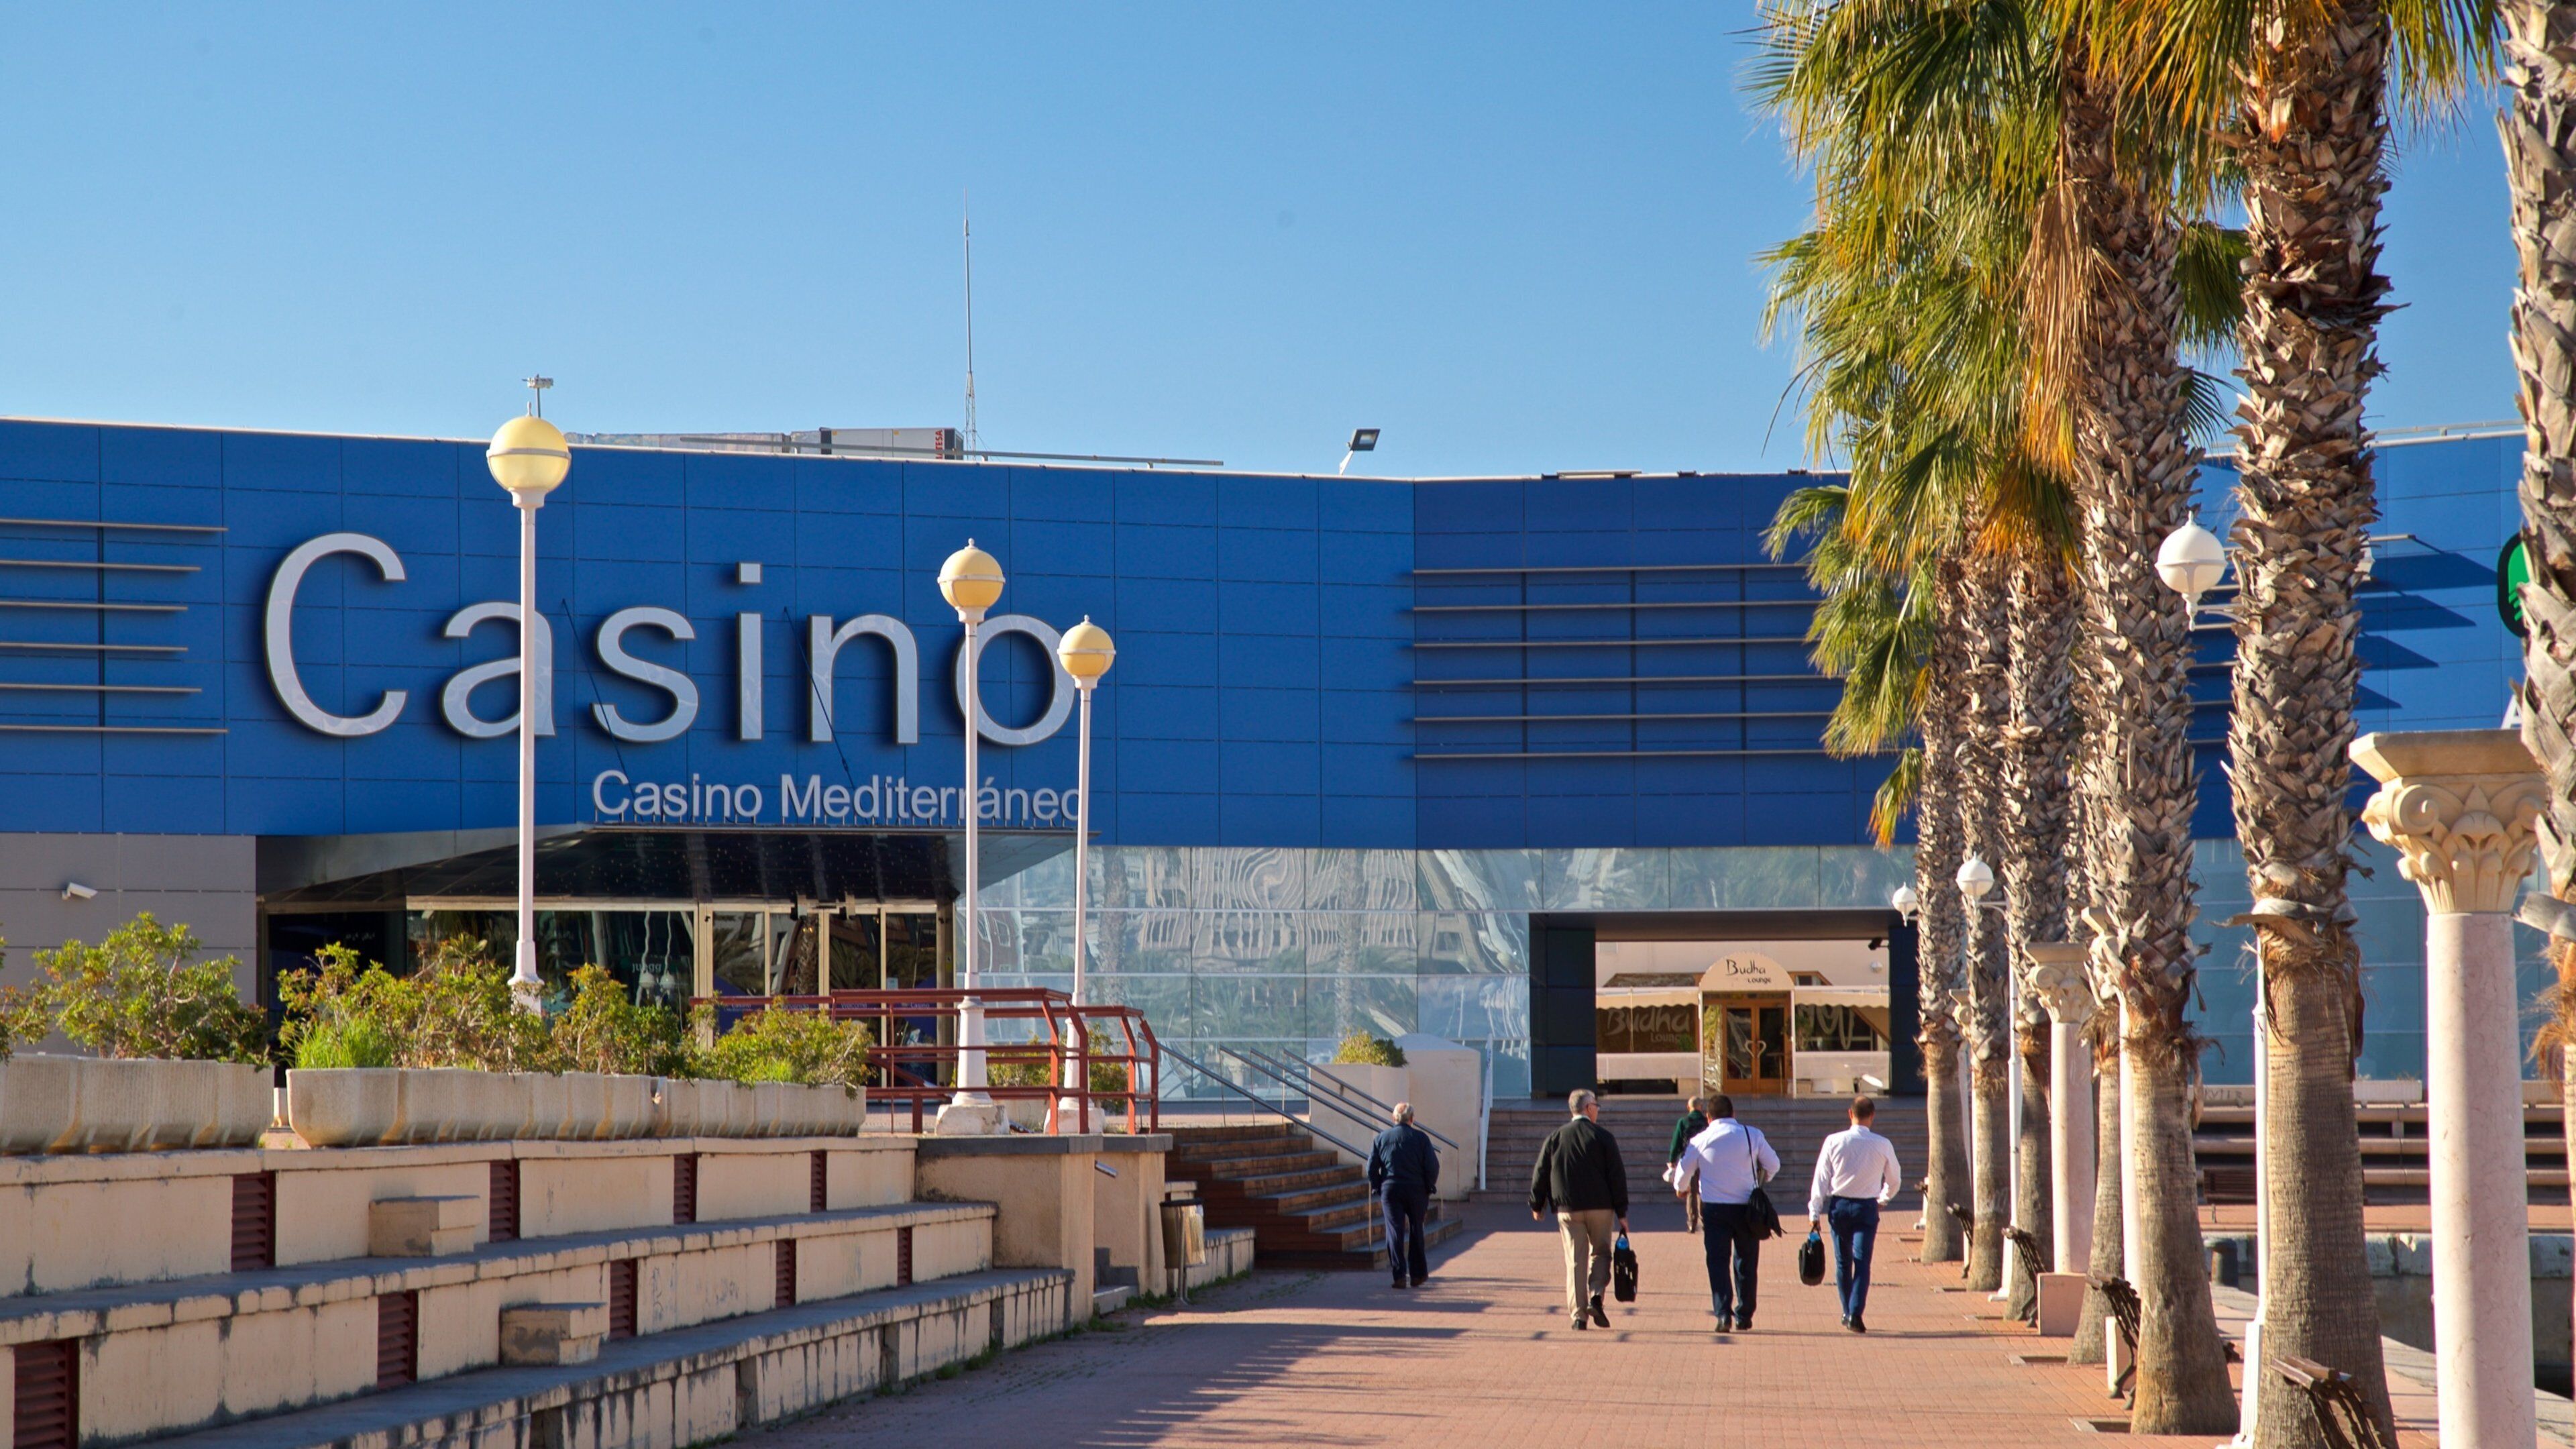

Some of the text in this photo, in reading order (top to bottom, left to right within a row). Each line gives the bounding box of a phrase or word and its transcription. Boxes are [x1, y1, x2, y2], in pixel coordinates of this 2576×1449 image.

[265, 532, 1075, 746] Casino
[593, 769, 762, 817] Casino
[1725, 959, 1766, 976] Budha
[1605, 1008, 1690, 1036] Budha
